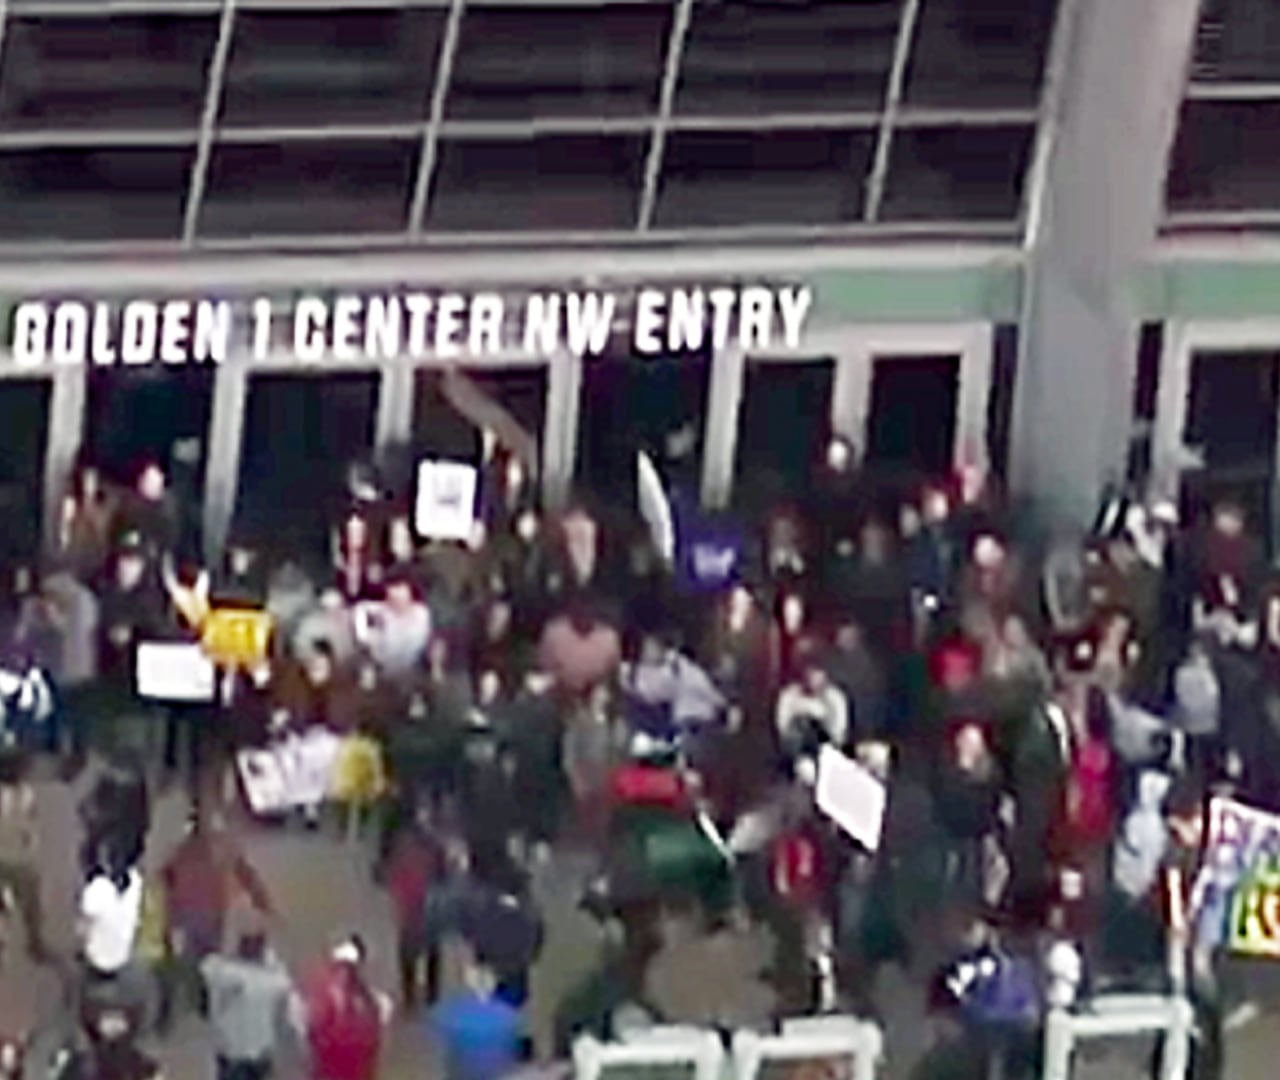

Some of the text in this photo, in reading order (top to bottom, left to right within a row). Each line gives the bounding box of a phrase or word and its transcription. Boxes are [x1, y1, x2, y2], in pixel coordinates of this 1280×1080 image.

[253, 297, 272, 363] 1
[294, 292, 504, 361] CENTER
[523, 290, 616, 356] NW
[634, 284, 812, 352] ENTRY
